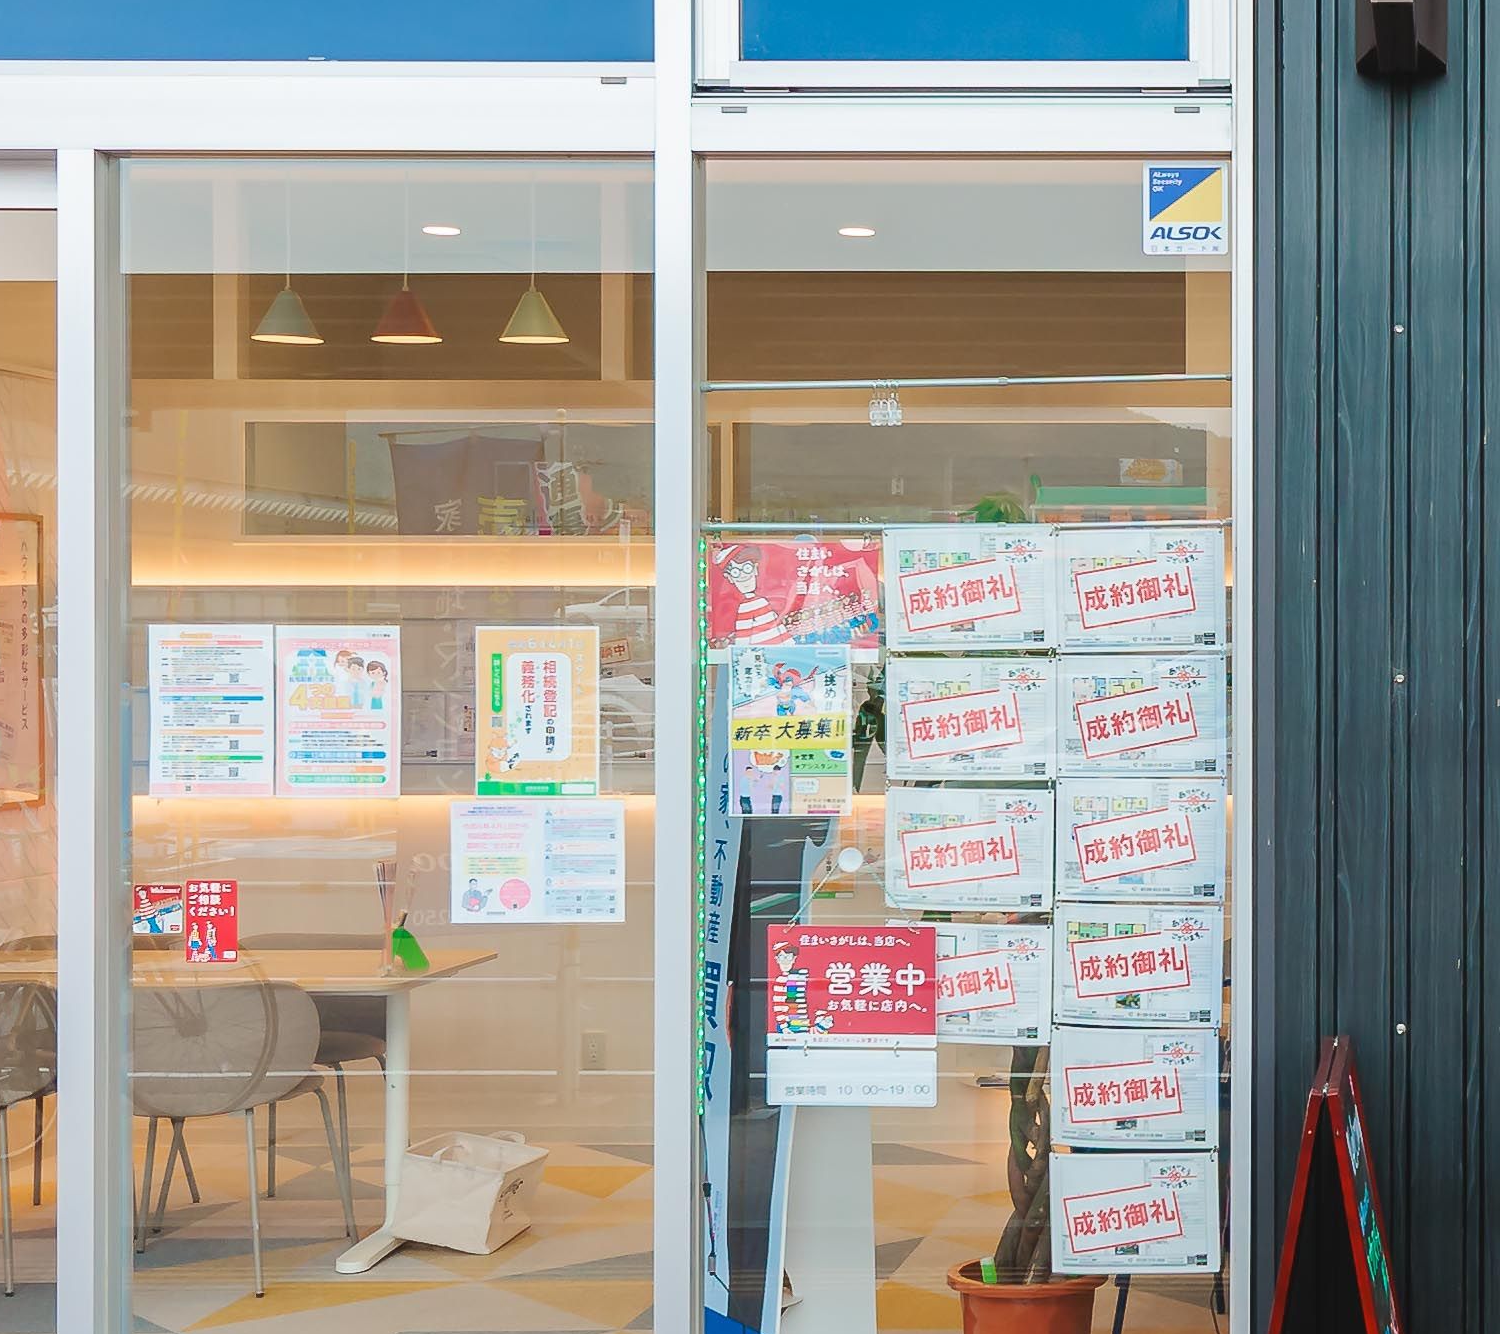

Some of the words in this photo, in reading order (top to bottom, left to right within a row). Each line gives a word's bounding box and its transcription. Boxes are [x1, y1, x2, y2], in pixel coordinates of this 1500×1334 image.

[1152, 171, 1180, 179] Always
[1152, 178, 1183, 186] Security
[1150, 226, 1222, 241] ALSOK
[795, 546, 833, 561] 住まい
[796, 565, 850, 579] さがしは、
[795, 581, 840, 596] 当店へ。
[908, 573, 1015, 615] 成約御礼
[1083, 571, 1191, 613] 成約御礼
[521, 660, 536, 735] 義務化されます
[543, 660, 557, 754] 相続登記の申請が
[733, 724, 772, 742] 新卒
[911, 701, 1017, 743] 成約御礼
[1086, 698, 1191, 742] 成約御礼
[909, 835, 1014, 871] 成約御礼
[1083, 820, 1190, 865] 成約御礼
[188, 882, 232, 894] お気軽に
[799, 934, 911, 947] 住まいさがしは、当店へ。
[825, 961, 926, 997] 営業中
[1079, 945, 1186, 981] 成約御礼
[827, 999, 928, 1013] お気軽に店内へ。
[784, 1085, 828, 1097] 営業時間
[1073, 1075, 1176, 1107] 成約御礼
[1072, 1197, 1176, 1237] 成約御礼
